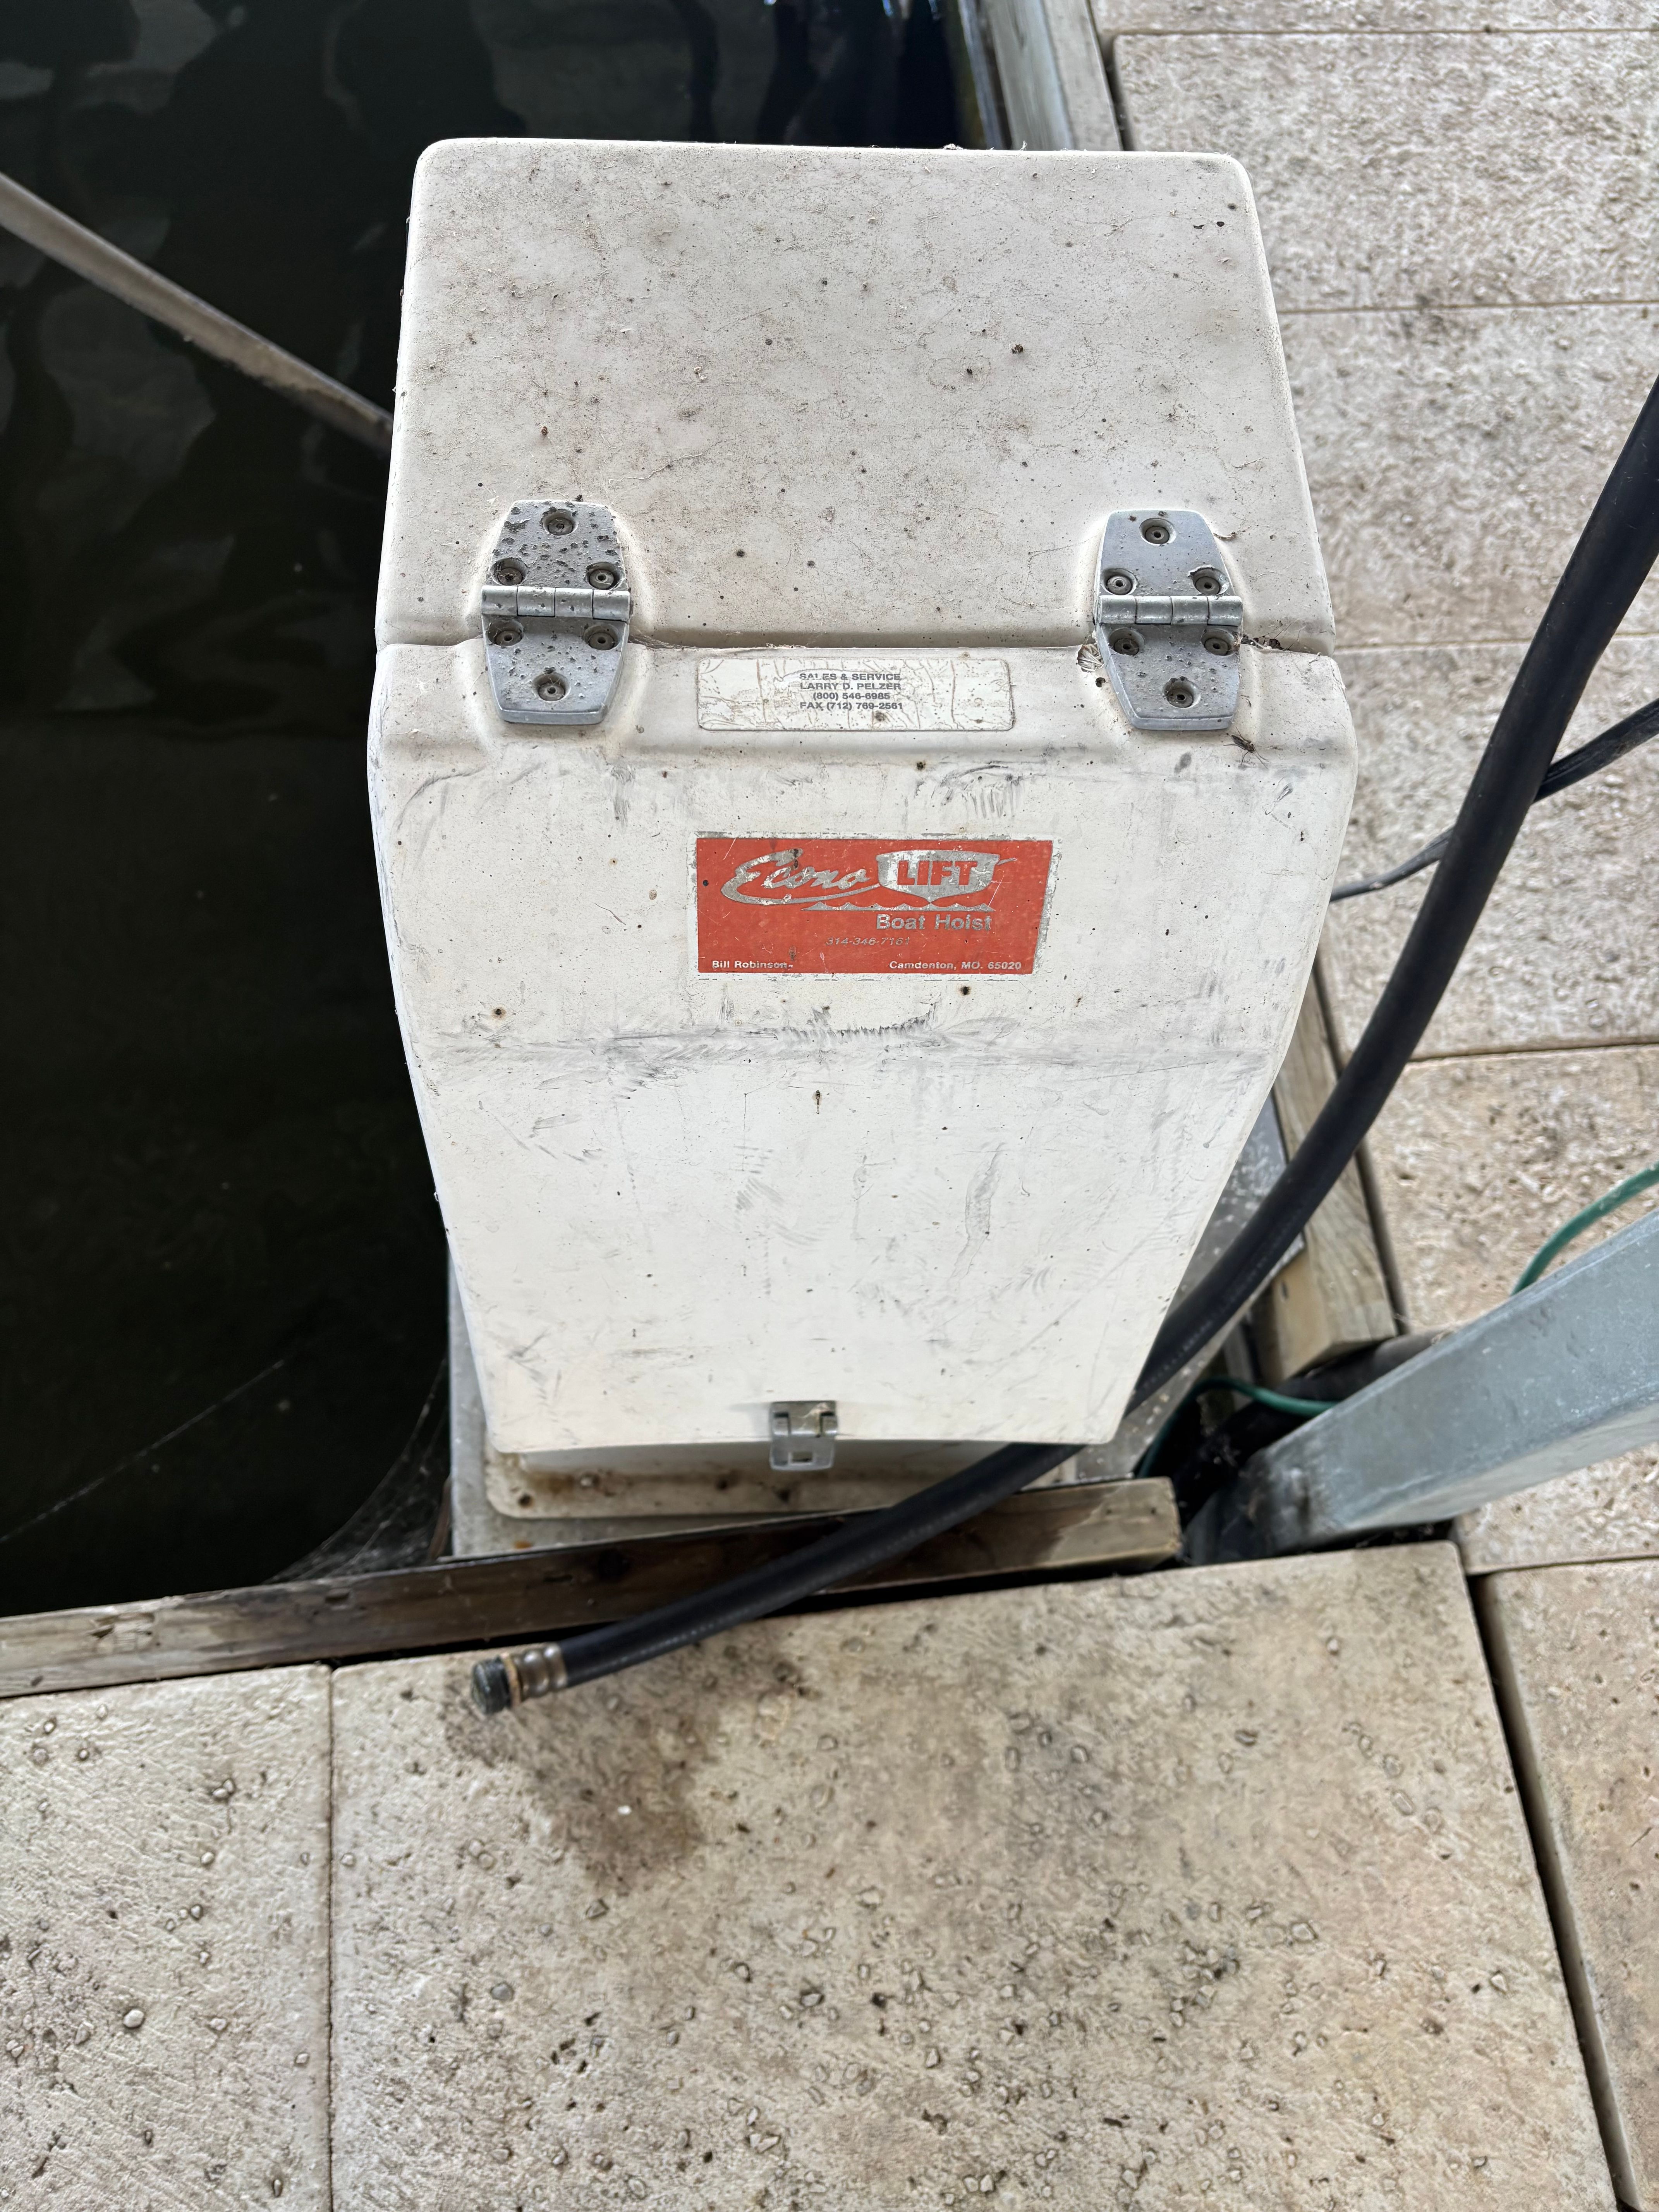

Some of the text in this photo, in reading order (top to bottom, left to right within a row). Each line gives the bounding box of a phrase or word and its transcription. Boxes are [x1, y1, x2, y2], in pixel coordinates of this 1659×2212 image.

[813, 692, 839, 701] (800)
[826, 702, 852, 711] (712)
[897, 860, 977, 886] LIFT
[876, 914, 993, 930] Boat Hoist
[889, 961, 957, 970] Camdenton,
[988, 962, 1021, 970] 65020
